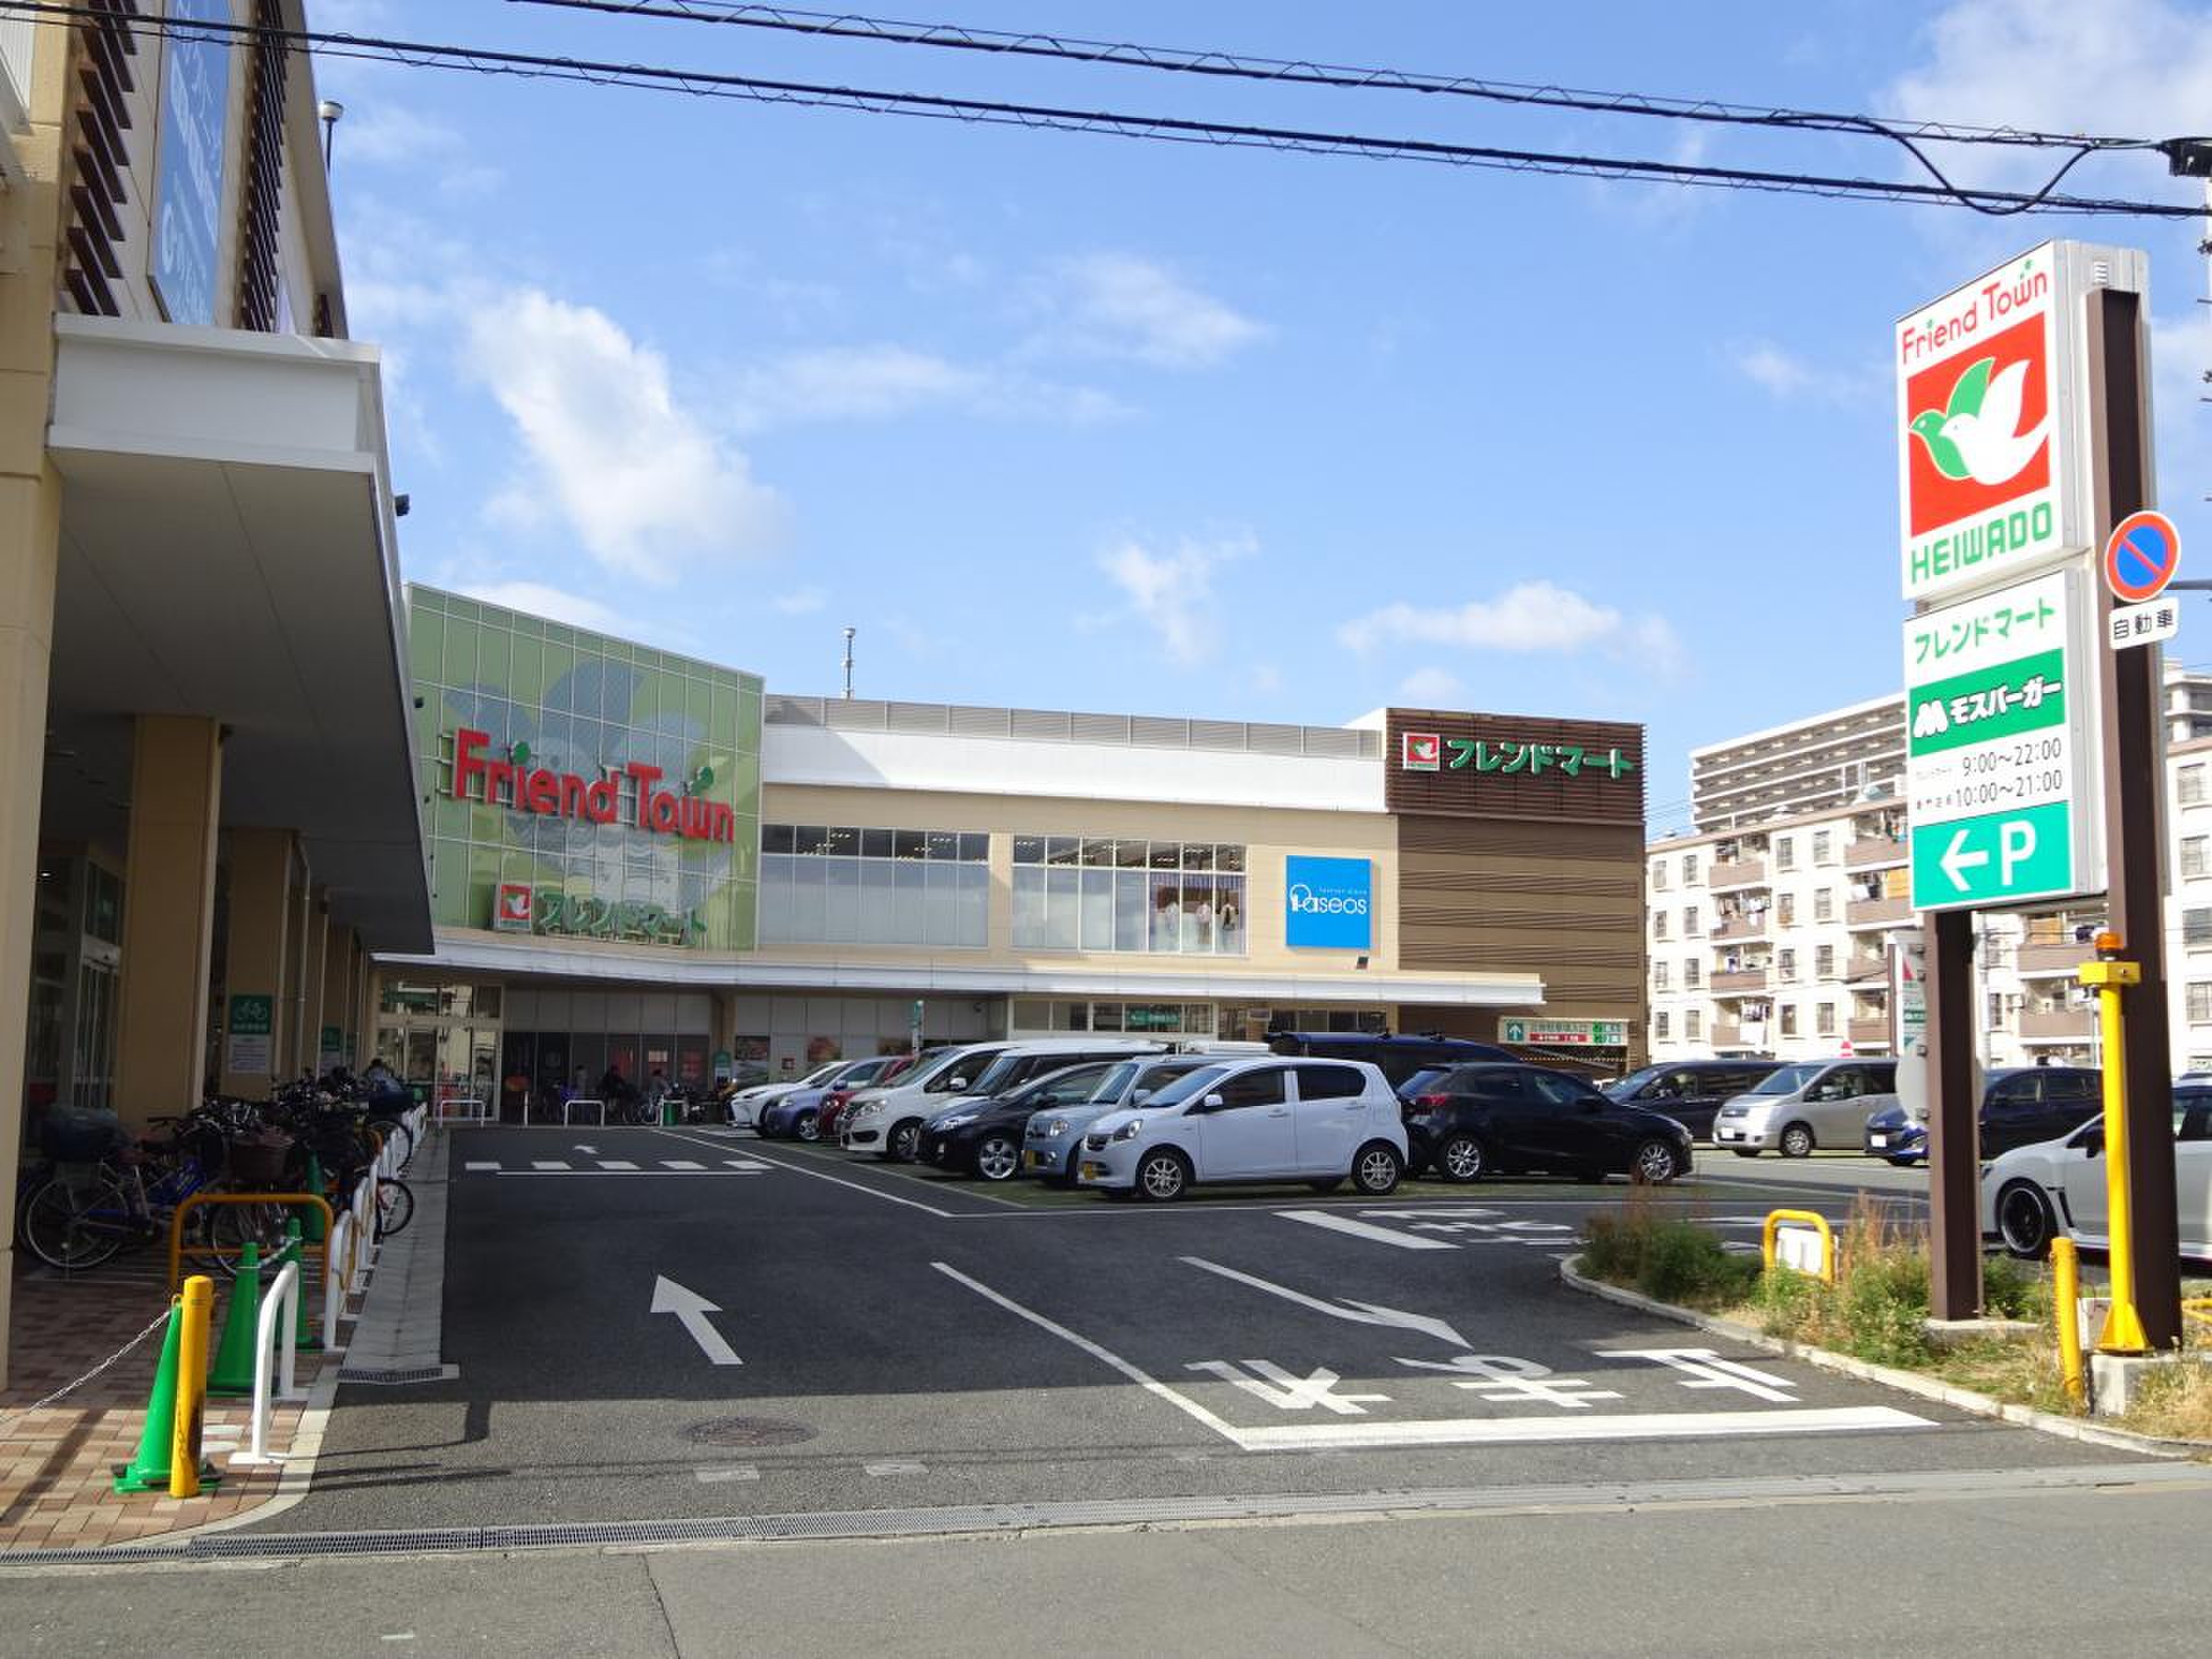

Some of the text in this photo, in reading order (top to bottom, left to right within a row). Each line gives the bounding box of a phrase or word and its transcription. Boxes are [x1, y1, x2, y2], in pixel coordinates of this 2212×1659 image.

[1902, 267, 2048, 365] Friend Town
[1912, 501, 2053, 584] HEIWADO
[1914, 598, 2055, 664] フレンドマート
[2113, 608, 2173, 640] 自動車
[1950, 675, 2062, 724] モスバーガー
[454, 728, 735, 843] Friend Town
[1447, 740, 1633, 779] フレンドマート
[2000, 820, 2036, 886] P
[1289, 883, 1368, 914] Paseos
[1182, 1348, 1804, 1415] 止まれ
